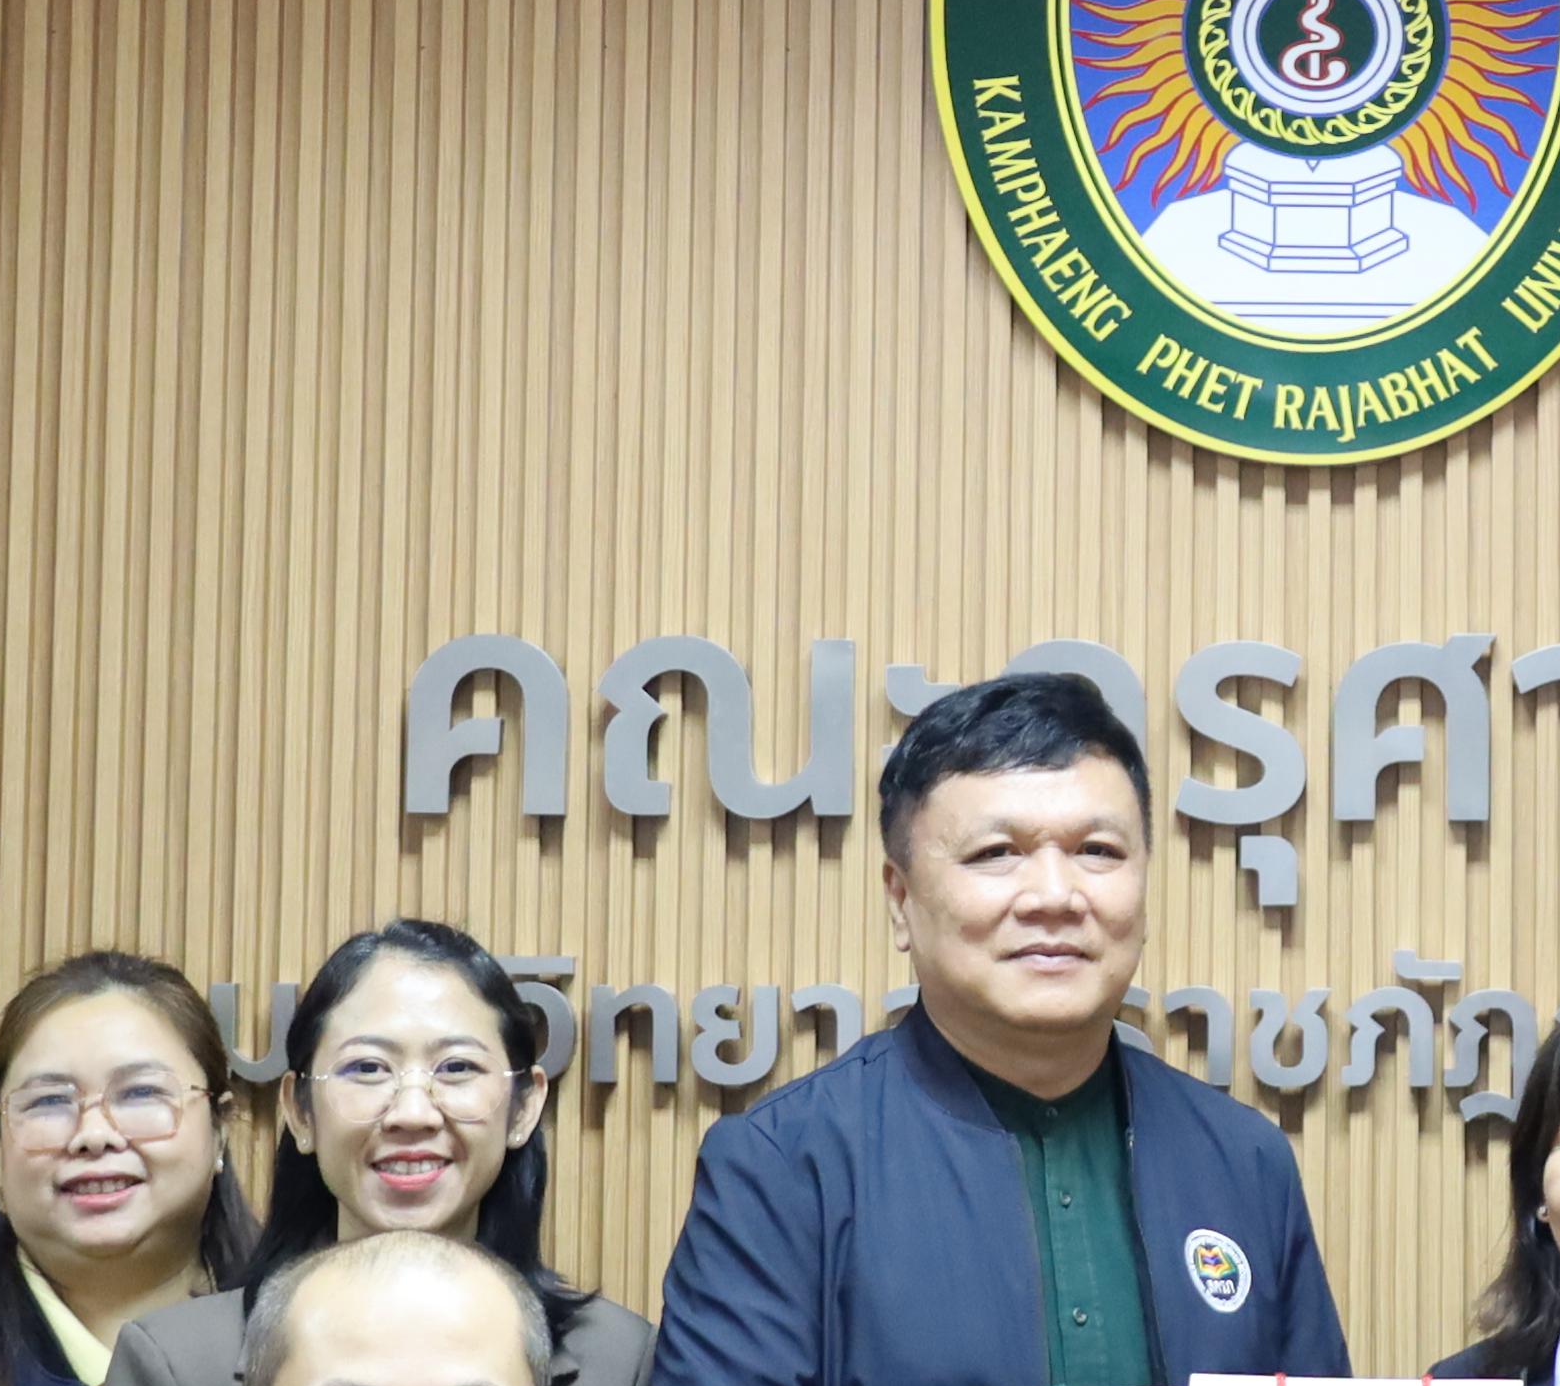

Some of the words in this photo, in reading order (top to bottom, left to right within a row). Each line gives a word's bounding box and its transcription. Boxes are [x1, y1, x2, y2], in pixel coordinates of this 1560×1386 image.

[972, 74, 1134, 343] KAMPHAENG
[1136, 332, 1263, 420] PHET
[1273, 326, 1501, 443] RAJABHAT
